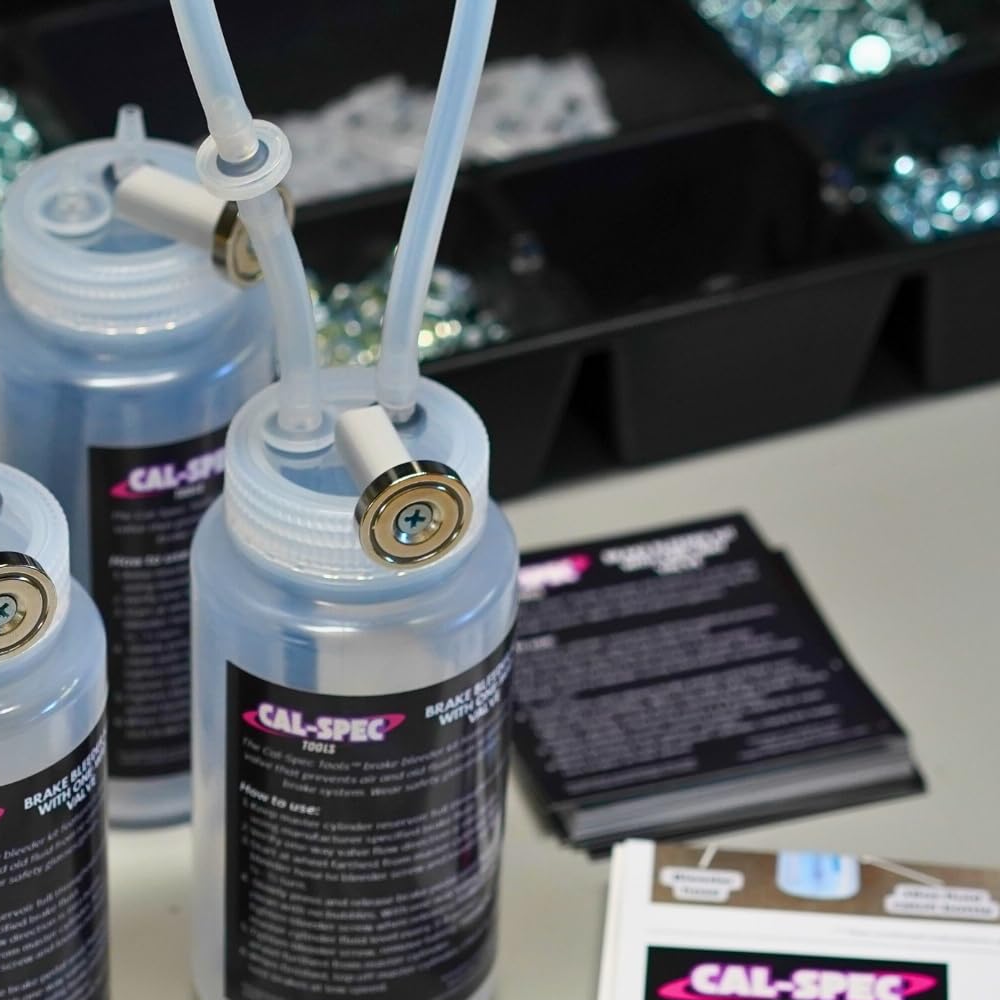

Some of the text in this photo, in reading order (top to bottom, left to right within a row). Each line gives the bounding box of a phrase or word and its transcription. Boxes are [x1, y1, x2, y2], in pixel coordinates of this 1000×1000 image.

[258, 703, 385, 742] CAL-SPEC
[302, 740, 336, 755] TOOLS
[24, 776, 68, 810] BRAKE
[38, 788, 71, 816] WITH
